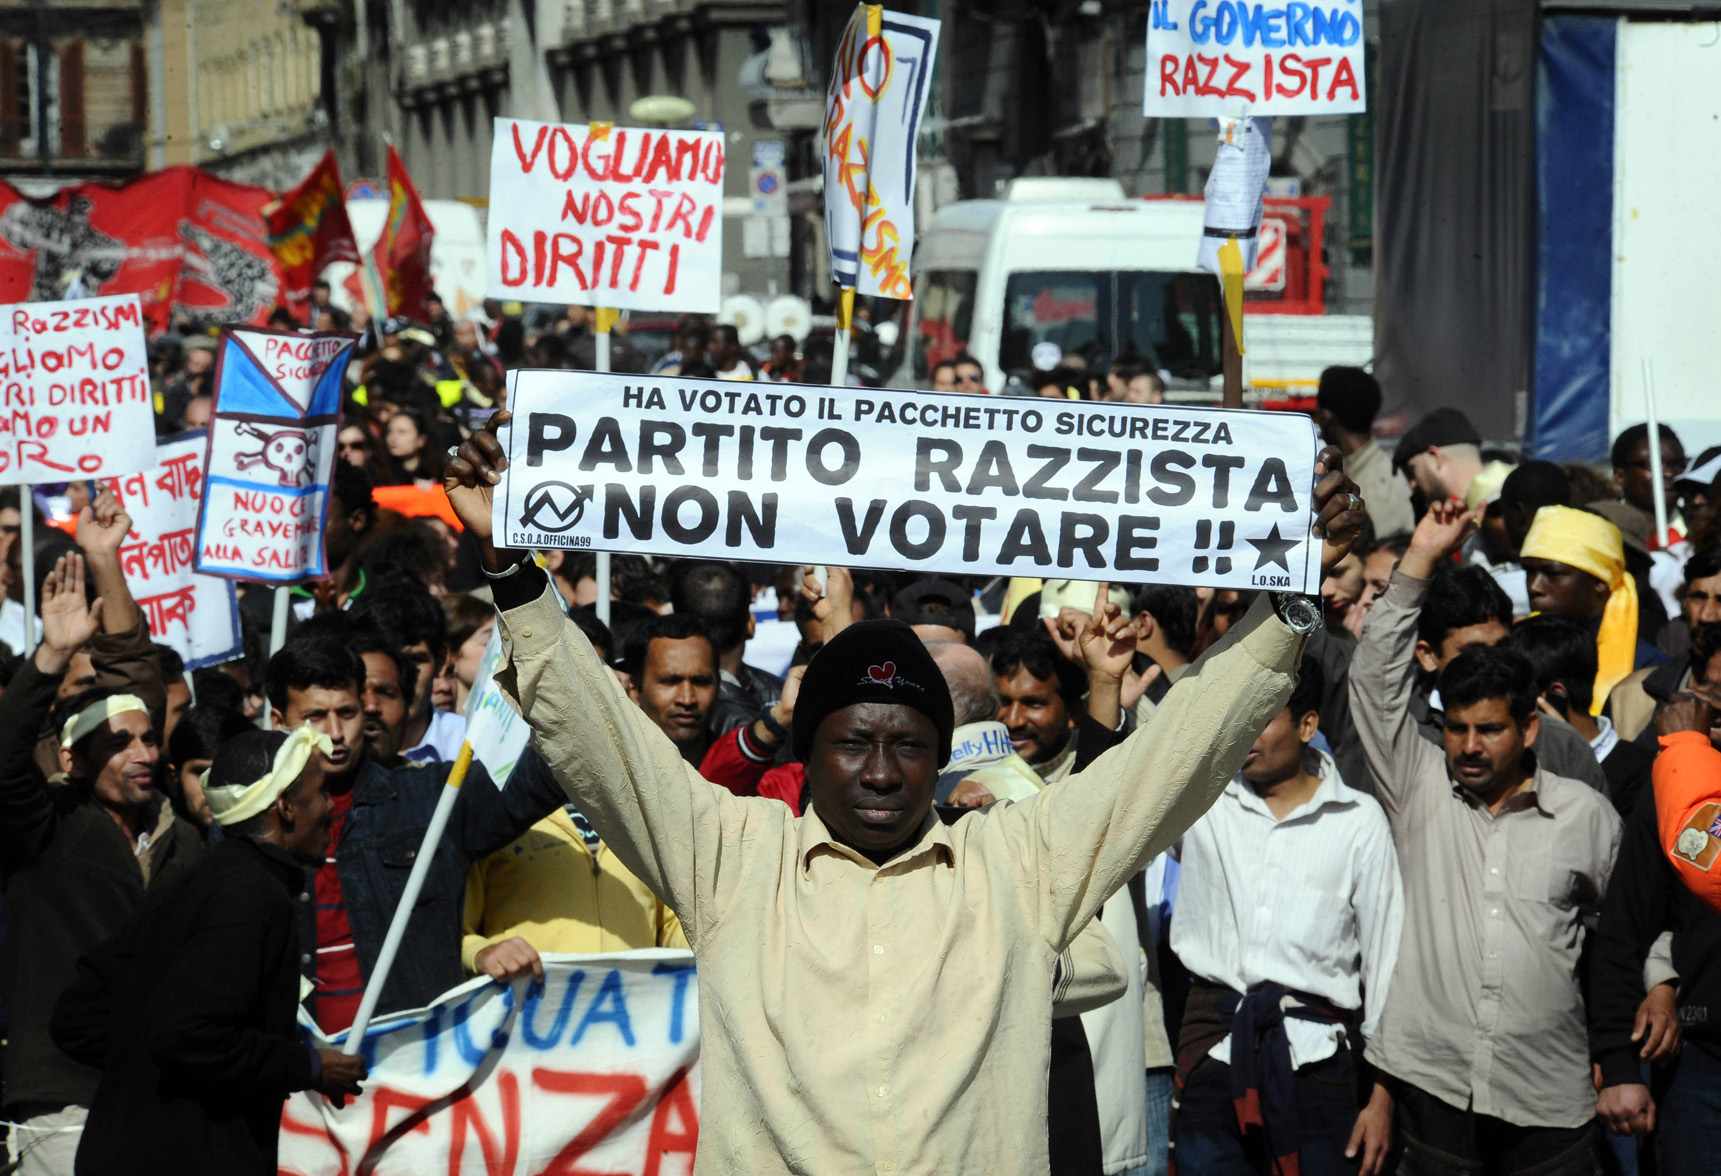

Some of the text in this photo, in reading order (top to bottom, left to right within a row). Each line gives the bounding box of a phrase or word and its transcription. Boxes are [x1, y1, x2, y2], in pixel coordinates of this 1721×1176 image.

[1153, 0, 1360, 48] IL GOVERNO
[1160, 53, 1359, 103] RAZZISTA
[511, 122, 724, 185] VOGLIAMO
[562, 189, 715, 243] NOSTRI
[501, 228, 679, 295] DIRITTI
[69, 410, 112, 436] UN
[622, 385, 1234, 445] HA VOTATO IL PACCHETTO SICUREZZA
[526, 411, 1299, 512] PARTITO RAZZISTA
[203, 543, 243, 562] ALLA
[602, 482, 779, 549] NON
[834, 496, 1161, 572] VOTARE
[1251, 575, 1291, 587] L.O.SKA
